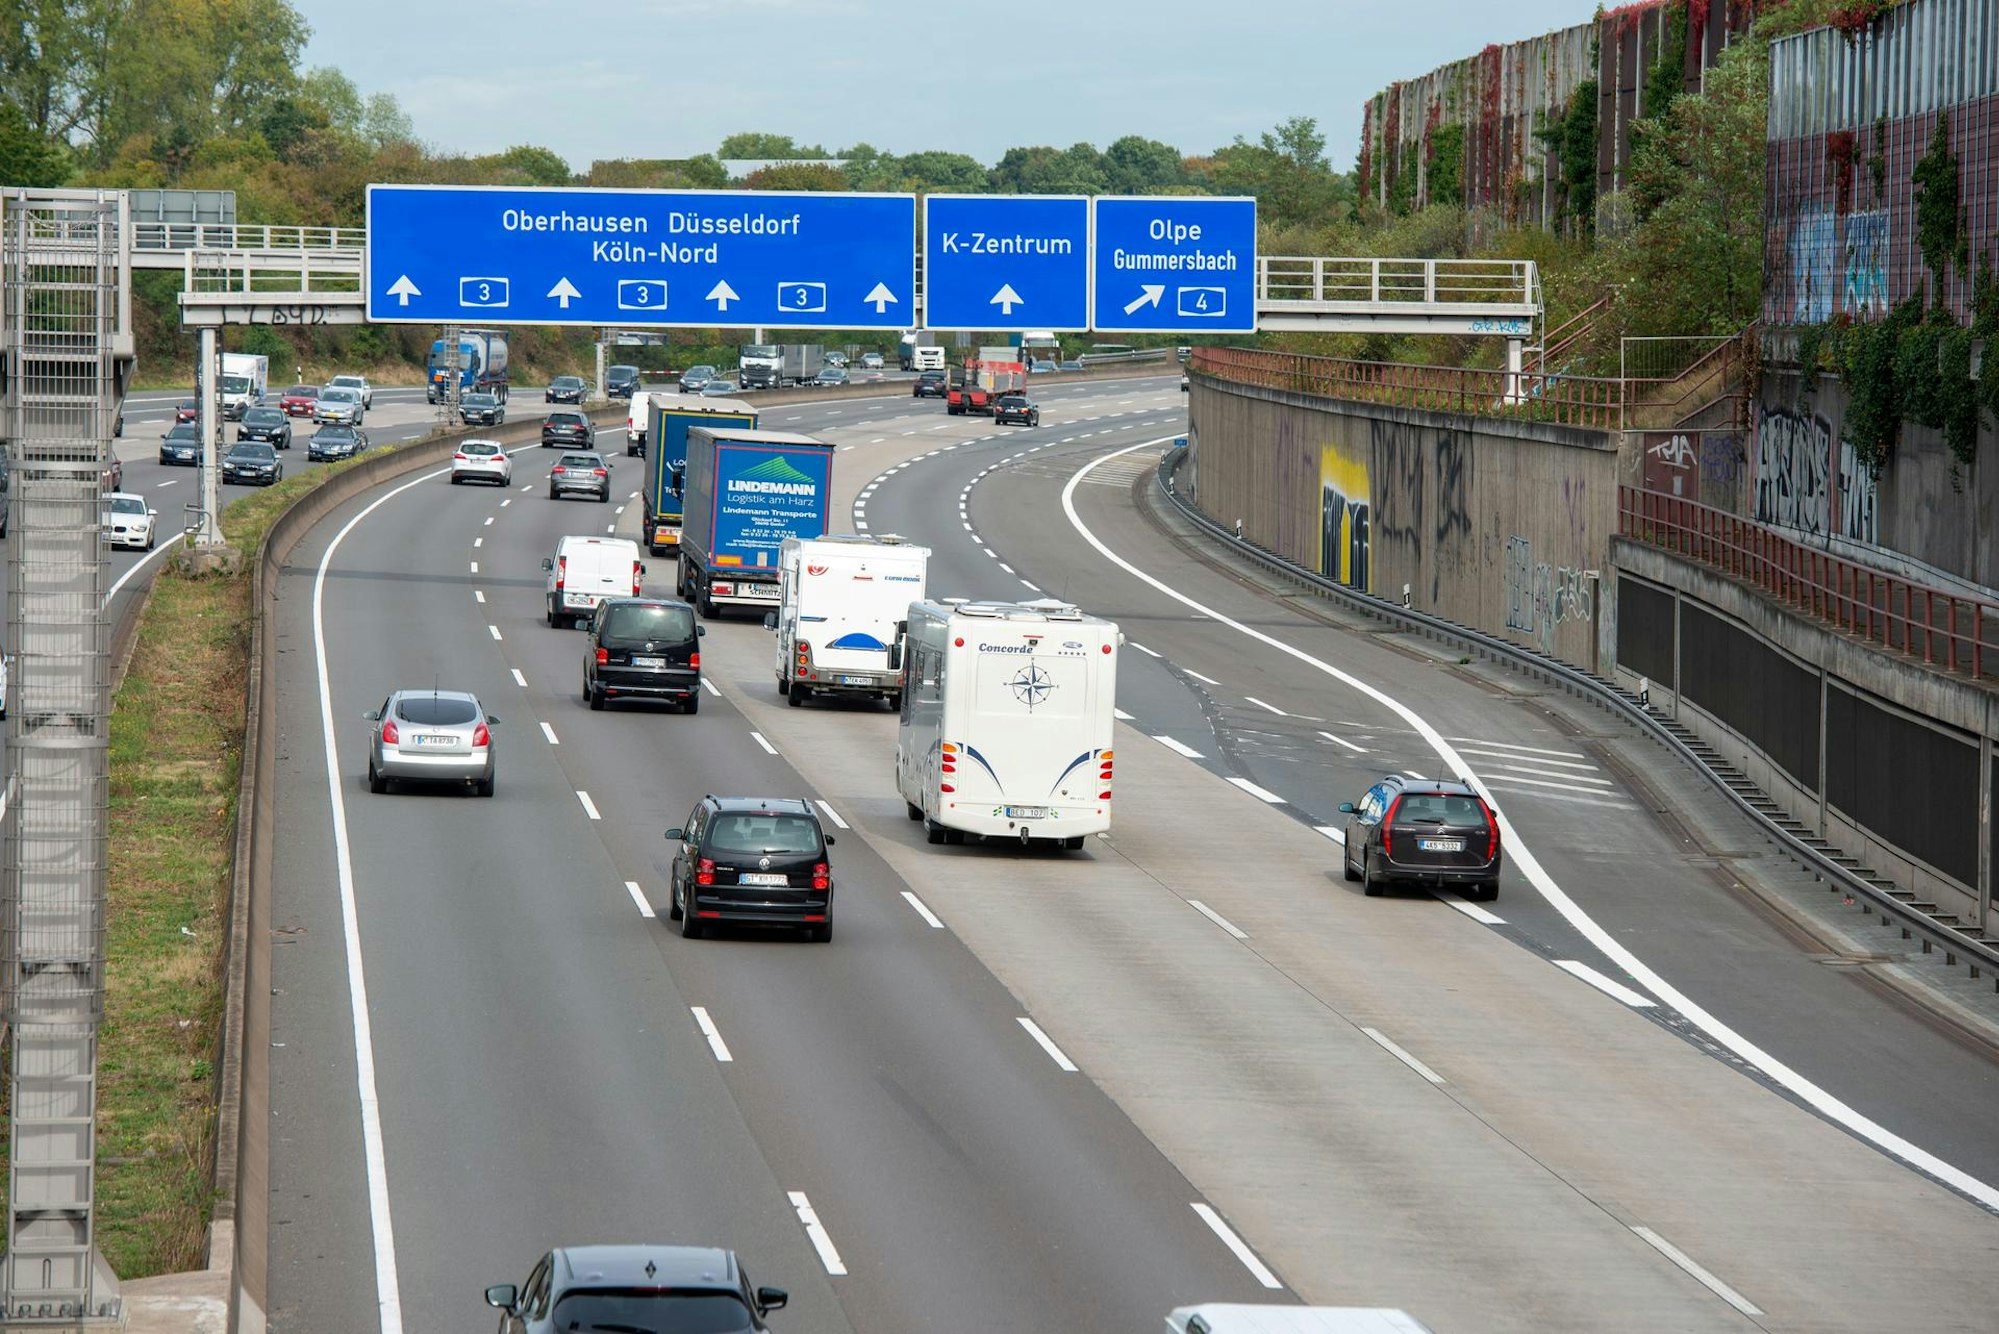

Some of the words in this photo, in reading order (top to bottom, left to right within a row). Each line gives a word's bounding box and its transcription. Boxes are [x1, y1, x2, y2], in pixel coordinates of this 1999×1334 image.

[502, 209, 648, 233] Oberhausen
[668, 212, 801, 235] Düsseldorf
[1149, 219, 1202, 245] Olpe
[942, 232, 1072, 254] K-Zentrum
[592, 241, 718, 264] Köln-Nord
[1113, 248, 1237, 271] Gummersbach
[479, 283, 490, 301] 3
[637, 285, 649, 304] 3
[796, 288, 807, 306] 3
[1196, 293, 1207, 311] 4
[728, 480, 815, 496] LINDEMANN
[727, 493, 766, 505] Logistik
[769, 496, 785, 504] am
[789, 497, 814, 507] Harz
[722, 506, 769, 516] Lindemann
[771, 509, 818, 519] Transporte
[978, 643, 1033, 654] Concorde
